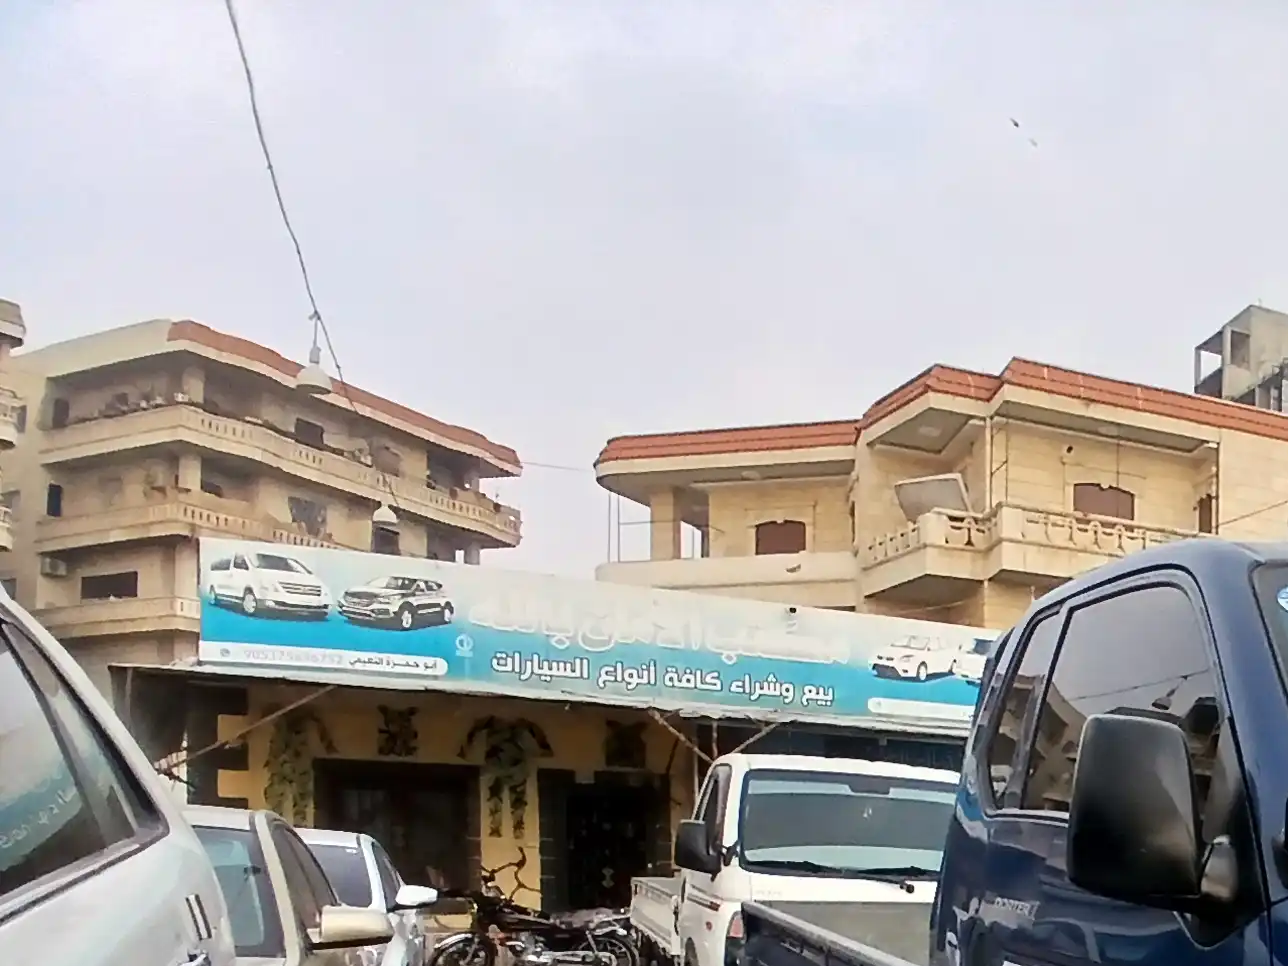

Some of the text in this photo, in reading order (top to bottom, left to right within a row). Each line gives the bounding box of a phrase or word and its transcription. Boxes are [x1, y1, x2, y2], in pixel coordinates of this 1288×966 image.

[491, 651, 835, 706] بيع وشراء كافة أنواع السيارات
